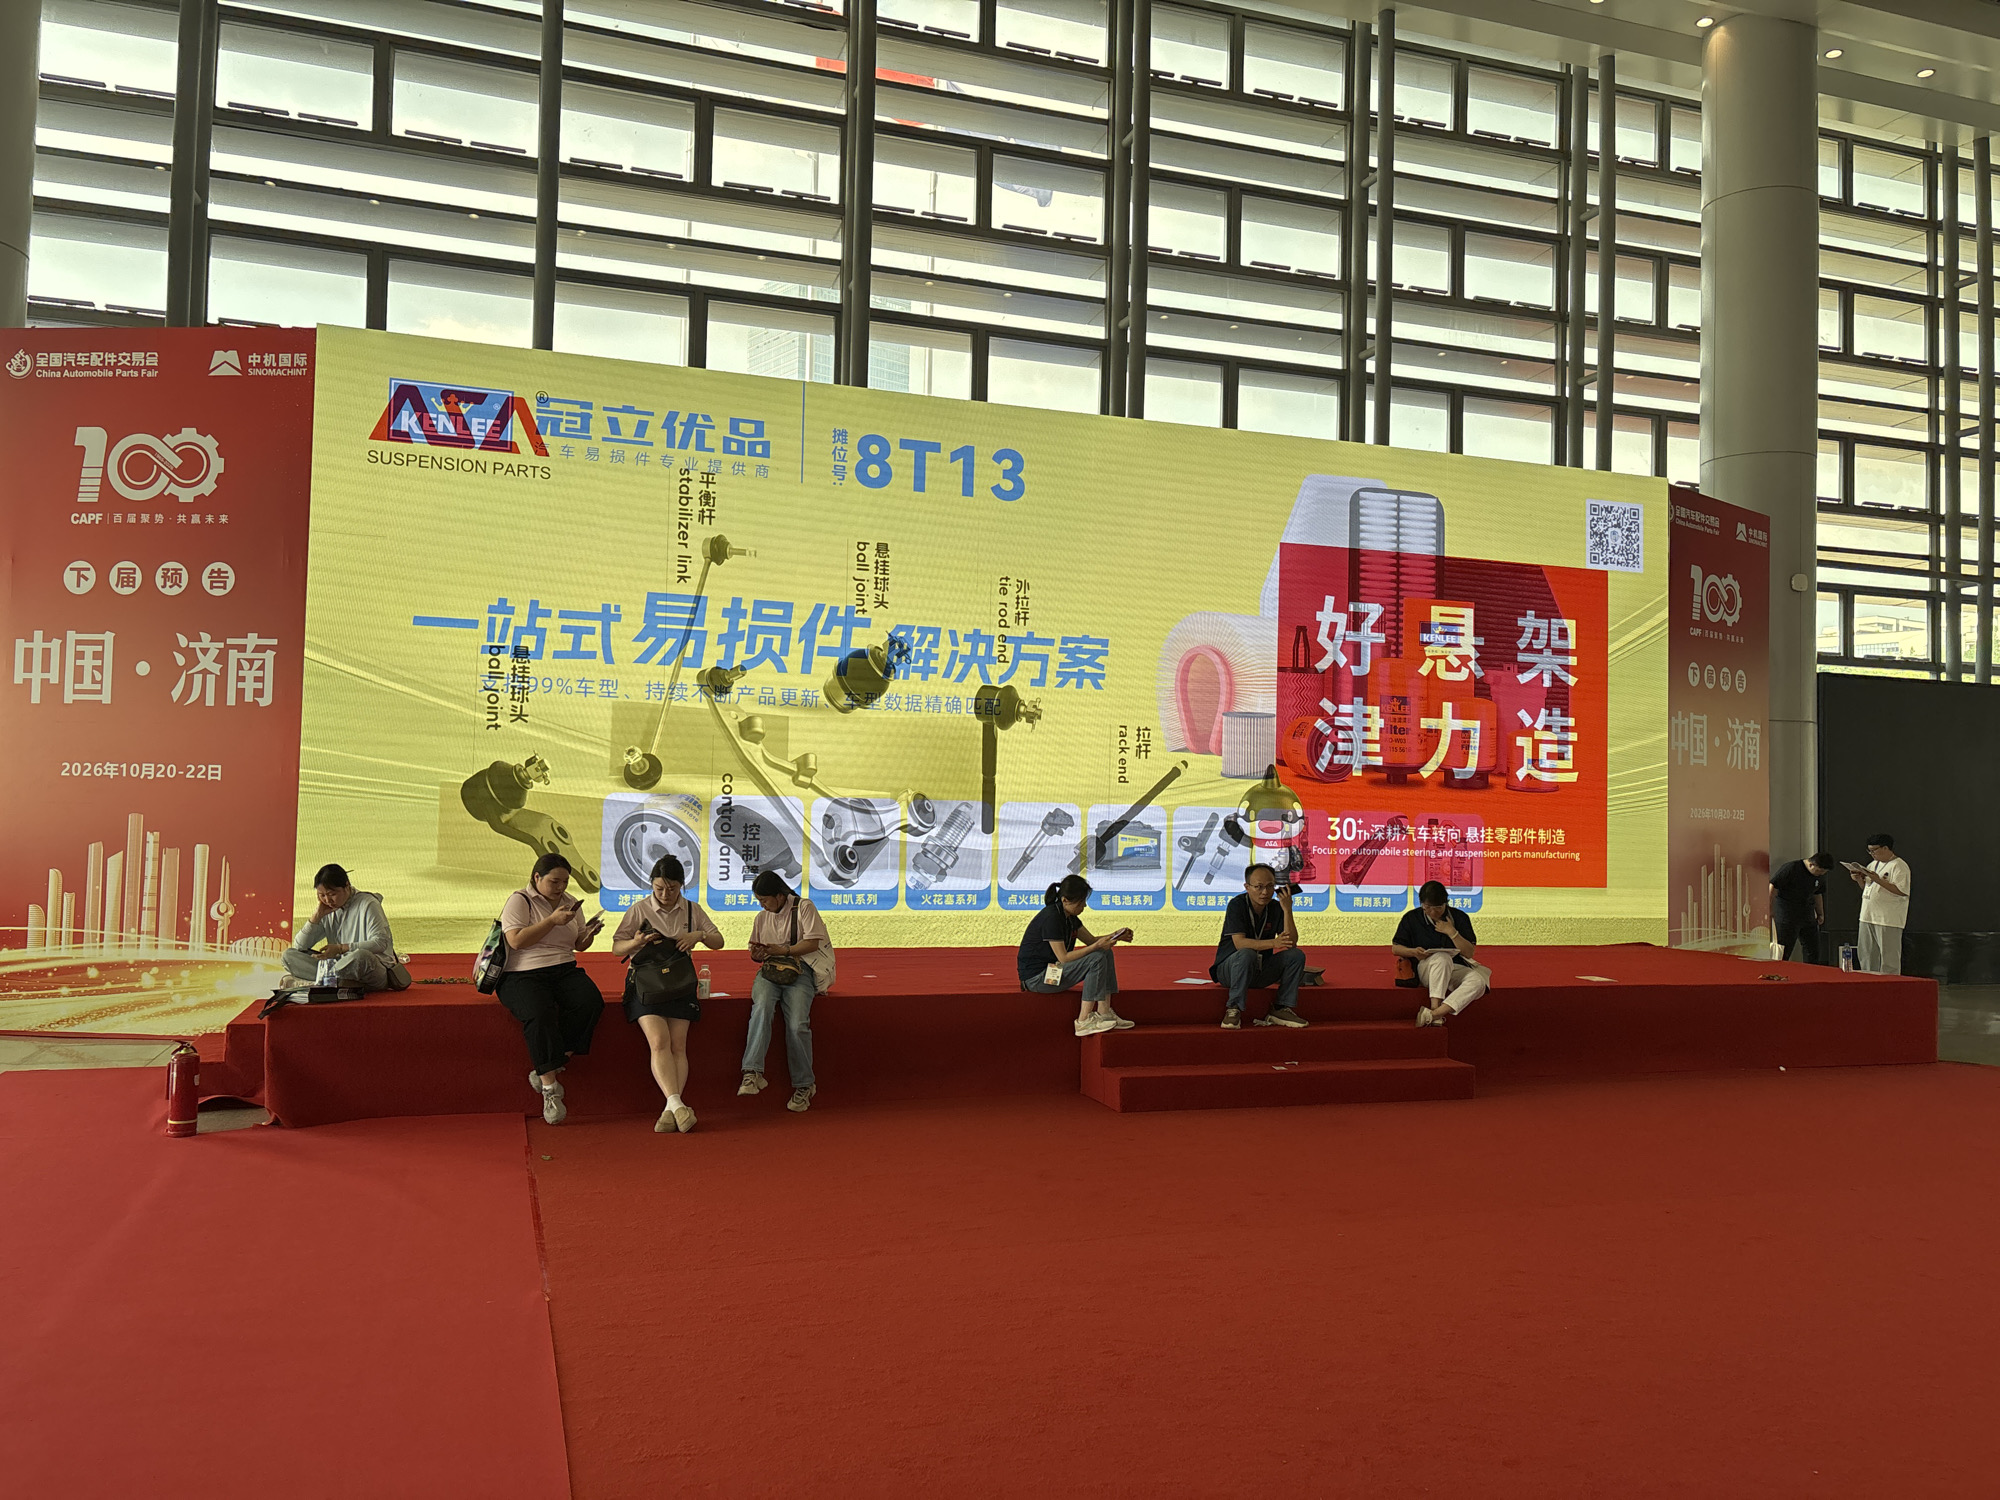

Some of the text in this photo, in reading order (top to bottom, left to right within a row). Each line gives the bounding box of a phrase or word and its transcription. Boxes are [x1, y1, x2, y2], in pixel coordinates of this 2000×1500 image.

[36, 351, 159, 367] 全国汽车配件交易会
[36, 368, 159, 378] China Automobile Parts Fair
[247, 353, 308, 367] 中机国际
[247, 367, 308, 377] SINOMACHINT
[400, 410, 501, 438] KENLEE
[535, 396, 771, 459] 冠立优品
[366, 449, 552, 480] SUSPENSION PARTS
[854, 433, 1026, 502] 8T13
[698, 471, 717, 526] 平衡杆
[70, 512, 103, 525] CAPF
[676, 467, 694, 584] stabilizer link
[66, 564, 232, 593] 下届预告
[852, 541, 870, 615] ball joint
[873, 542, 890, 610] 悬挂球头
[1014, 578, 1031, 627] 外拉杆
[997, 575, 1012, 664] tie rod end
[1422, 633, 1458, 644] KENLEE
[13, 630, 279, 708] 中国·济南
[1689, 664, 1746, 692] 下届预告
[483, 644, 506, 731] ball joint
[509, 645, 531, 724] 悬挂球头
[1117, 724, 1130, 784] rack end
[1135, 726, 1151, 760] 拉杆
[1670, 710, 1761, 771] 中国·济南
[60, 762, 223, 781] 2026年10月20-22日
[718, 773, 735, 882] control arm
[1465, 826, 1566, 845] 悬挂零部件制造
[1312, 845, 1581, 862] Focus on automobile steering and suspension parts manufacturing
[830, 893, 879, 905] 喇叭系列
[921, 894, 977, 906] 火花塞系列
[1100, 894, 1153, 906] 蓄电池系列
[1353, 897, 1391, 908] 雨刷系列
